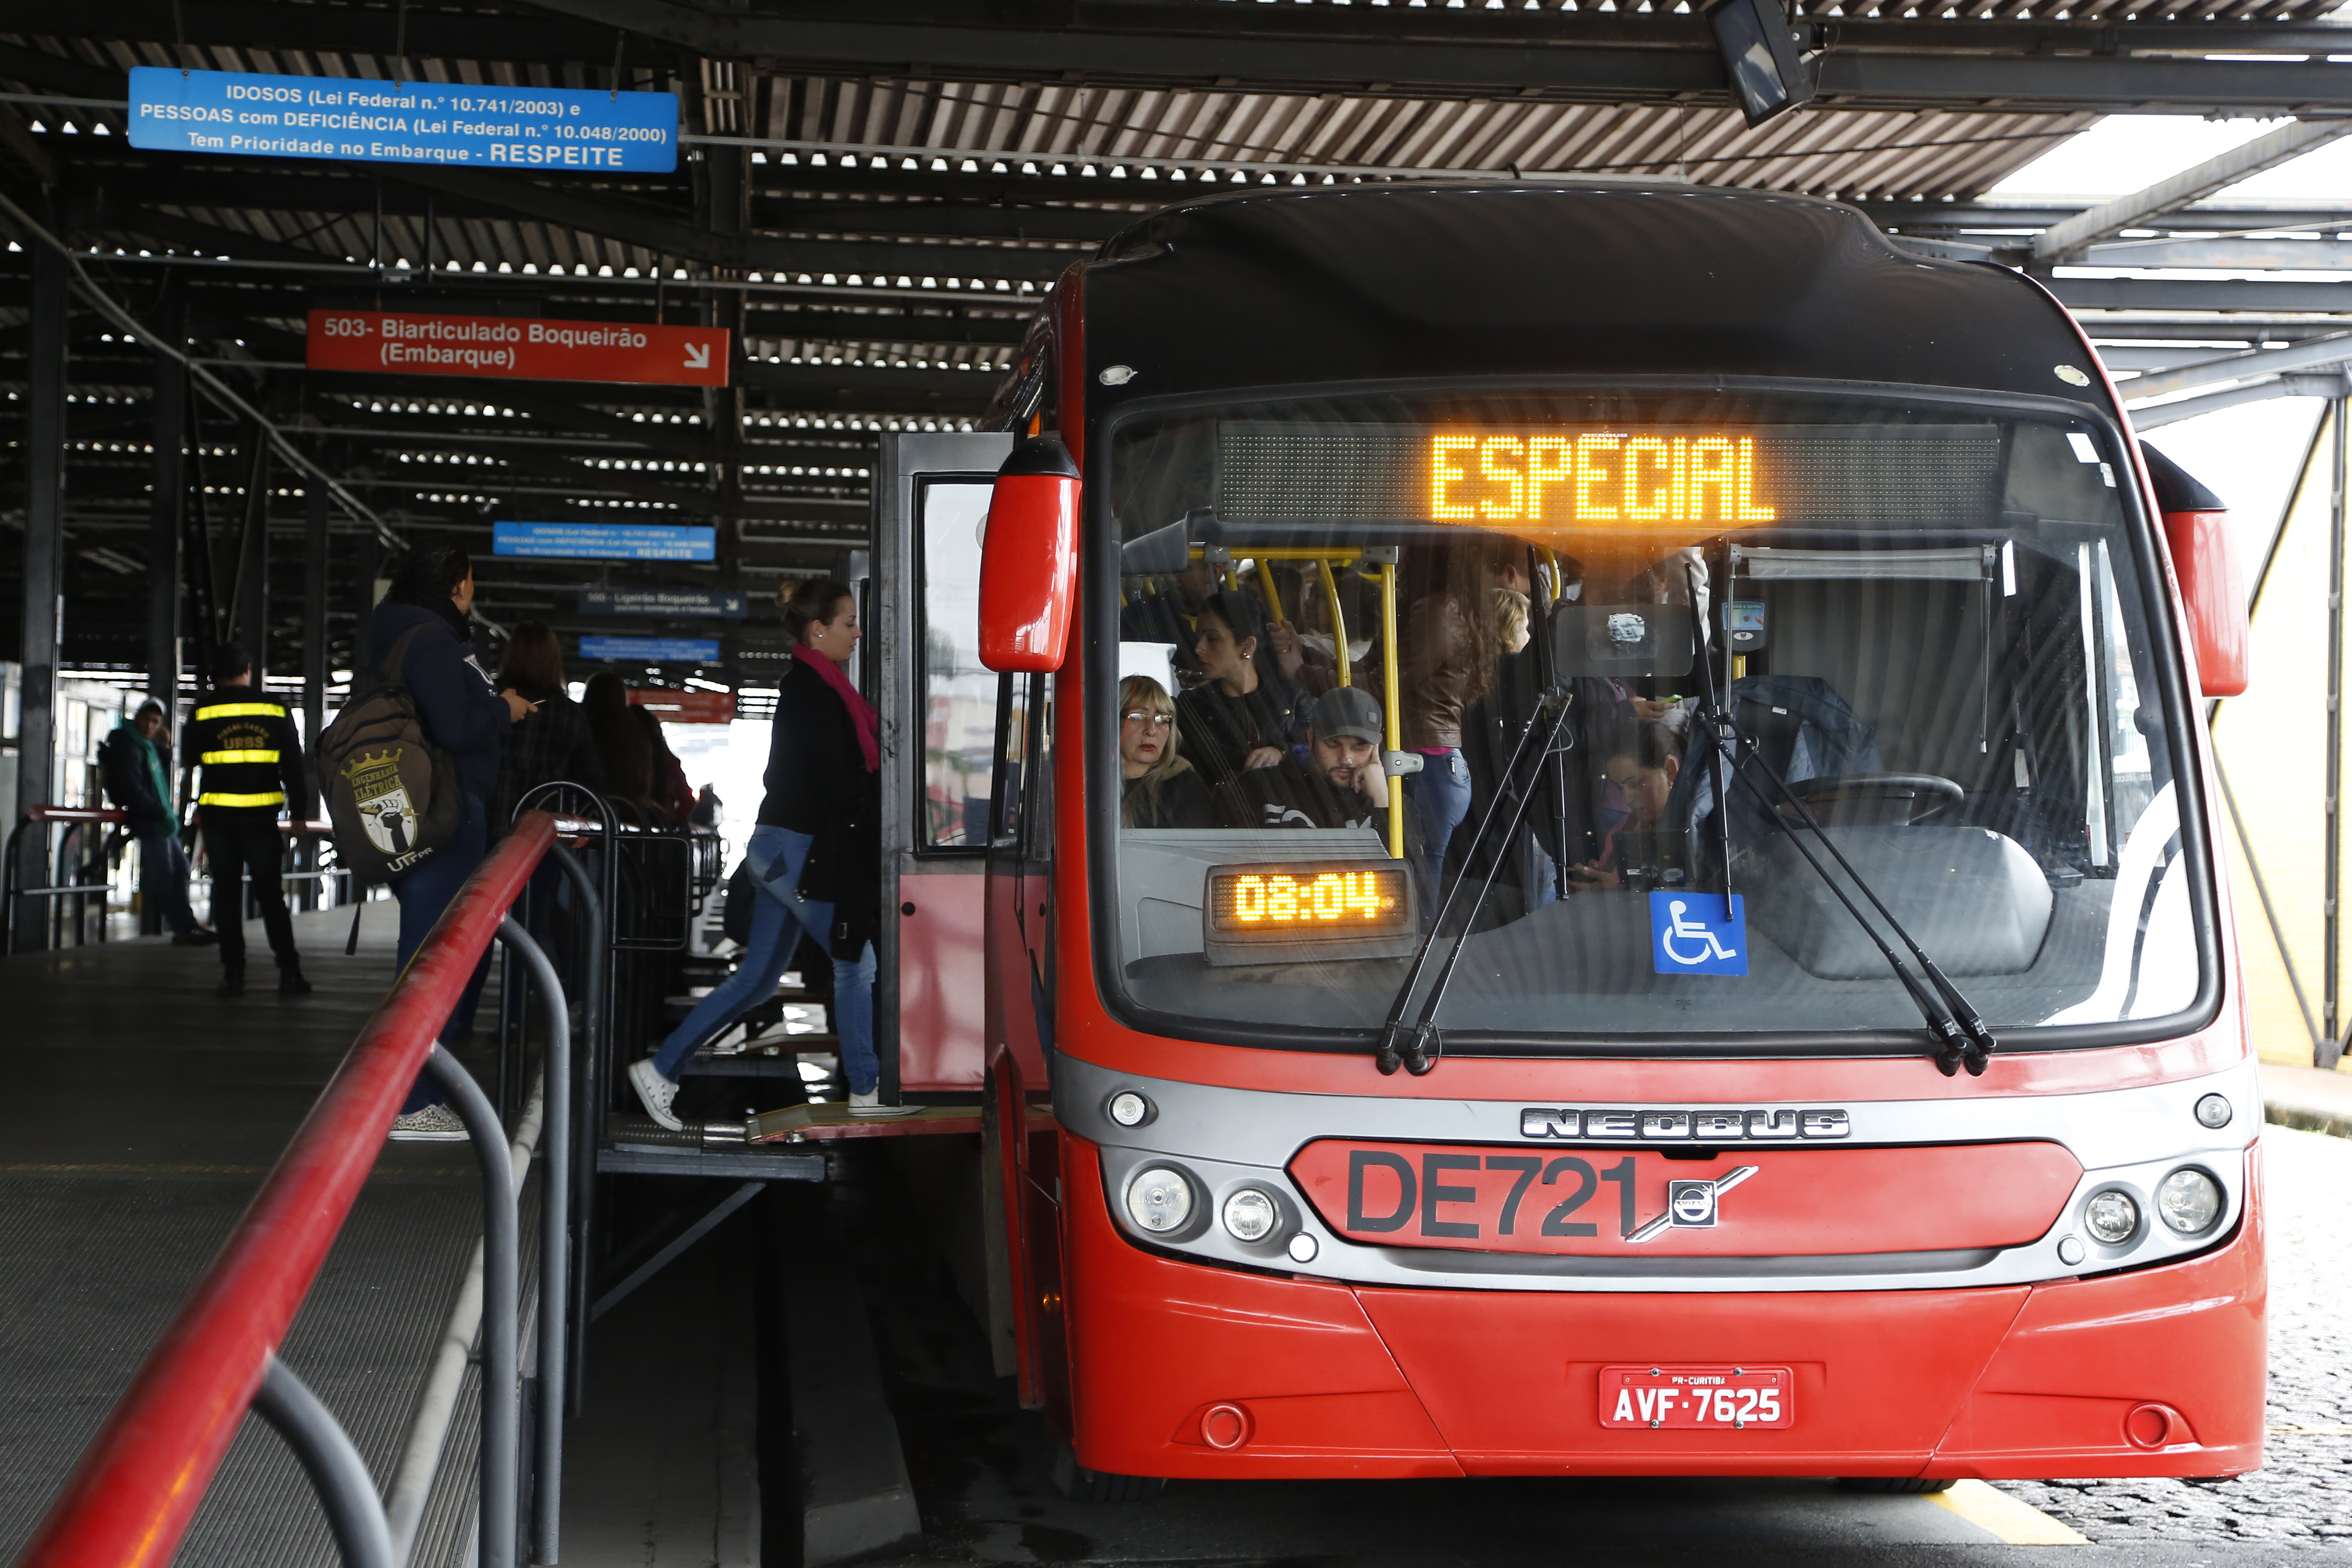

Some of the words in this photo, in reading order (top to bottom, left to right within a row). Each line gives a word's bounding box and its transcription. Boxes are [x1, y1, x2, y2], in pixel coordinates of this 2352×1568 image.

[227, 85, 302, 103] IDOSOS
[309, 90, 342, 107] (Lei
[348, 92, 415, 109] Federal
[451, 97, 563, 118] 10.741/2003)
[570, 104, 580, 115] e
[141, 103, 233, 123] PESSOAS
[239, 112, 278, 125] com
[284, 112, 407, 132] DEFICIÊNCIA
[413, 119, 447, 135] (Lei
[453, 121, 519, 137] Federal
[555, 125, 666, 144] 10.048/2000)
[187, 132, 223, 147] Tem
[231, 135, 334, 154] Prioridade
[340, 143, 364, 156] no
[371, 142, 469, 162] Embarque
[490, 143, 623, 166] RESPEITE
[324, 318, 374, 336] 503-
[381, 318, 521, 342] Biarticulado
[529, 323, 647, 348] Boqueirão
[380, 342, 515, 369] (Embarque)
[1432, 435, 1775, 519] ESPECIAL
[223, 736, 265, 749] URBS
[352, 764, 398, 787] ENGENHARIA
[354, 775, 402, 800] ELÉTRICA
[1236, 871, 1379, 921] 08:04
[1521, 1108, 1851, 1139] NEOBUS
[1346, 1150, 1636, 1239] DE721
[1672, 1376, 1726, 1385] PR-CURITIBA
